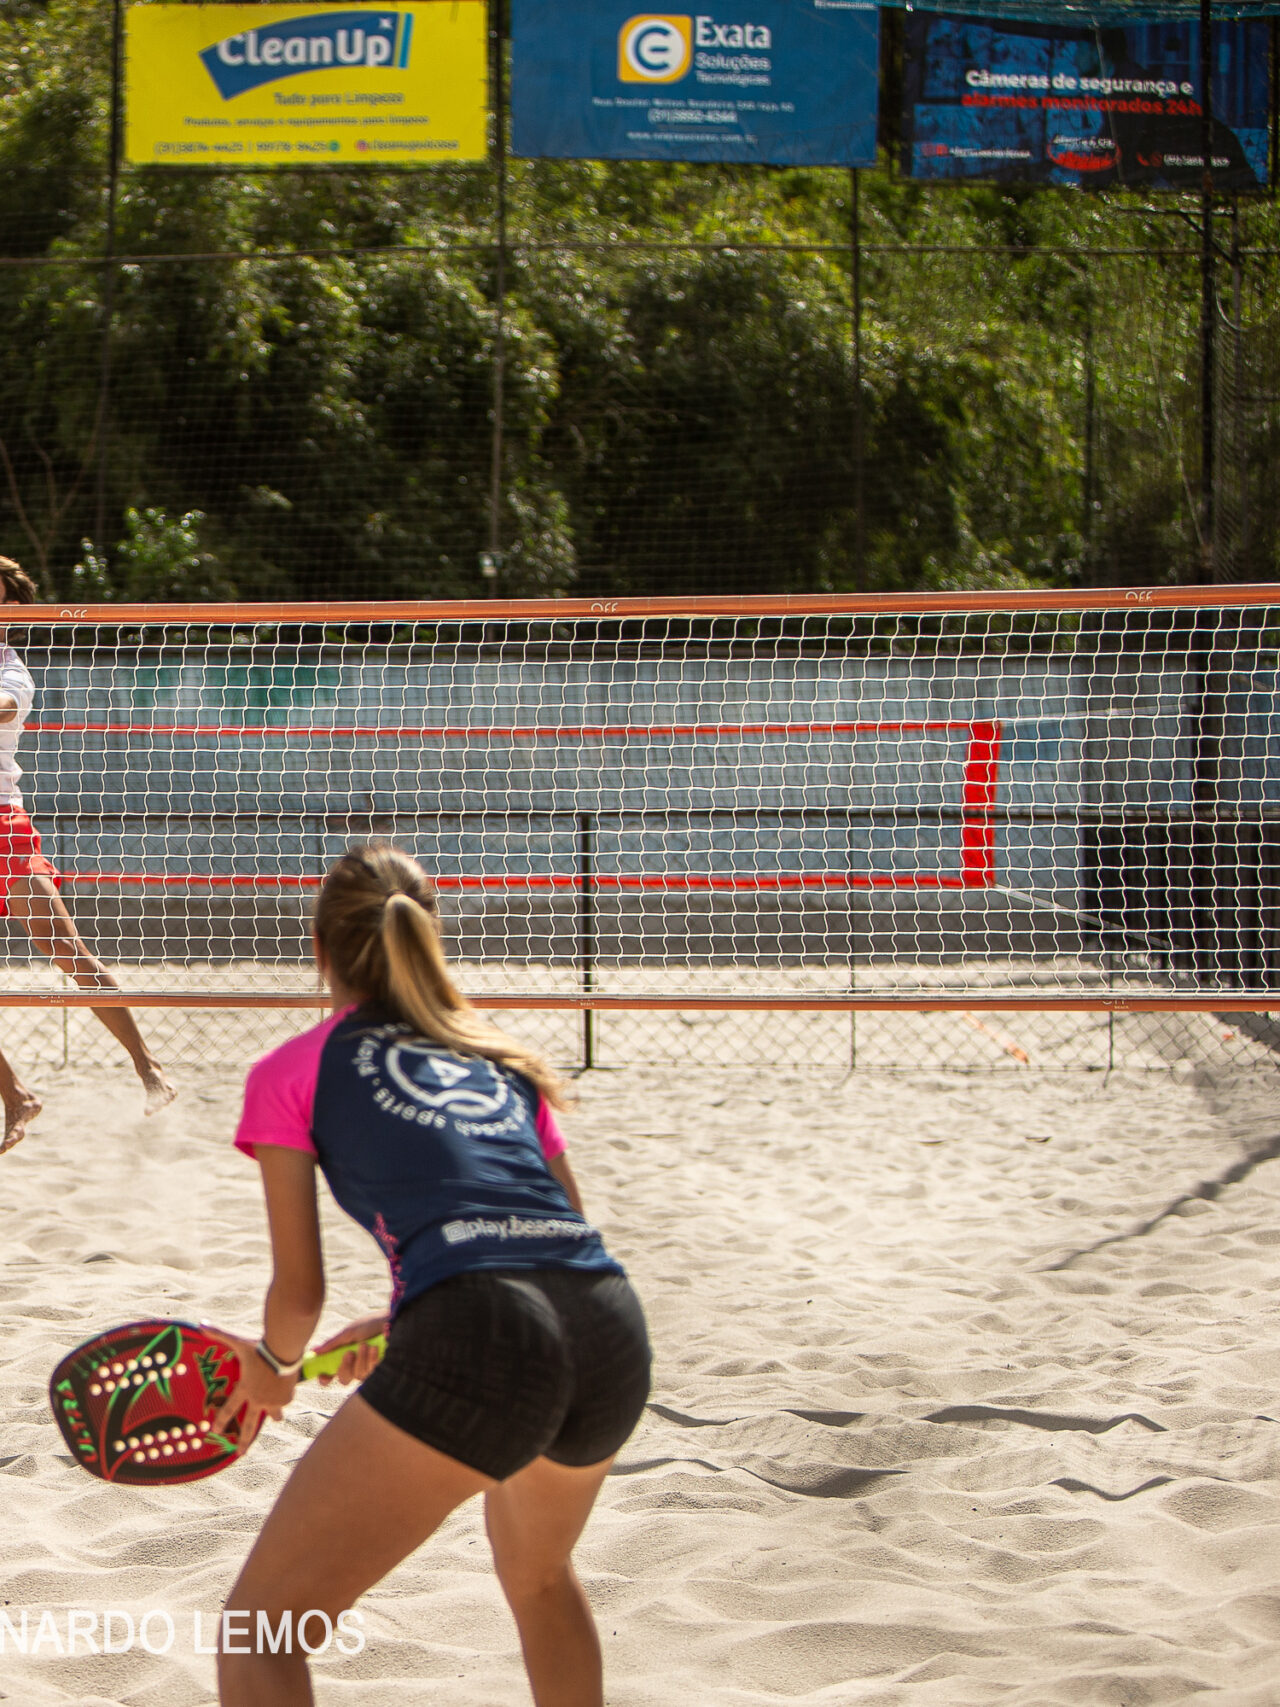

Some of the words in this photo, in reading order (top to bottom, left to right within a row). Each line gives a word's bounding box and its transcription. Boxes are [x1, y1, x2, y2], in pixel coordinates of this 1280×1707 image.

[695, 15, 772, 49] Exata
[695, 52, 772, 73] Soluções
[965, 69, 1050, 90] Câmeras
[1052, 72, 1078, 90] de
[1079, 76, 1177, 98] segurança
[1180, 81, 1194, 95] e
[1041, 94, 1163, 113] monitorados
[373, 1087, 447, 1130] sports
[57, 1378, 97, 1463] ULTRA
